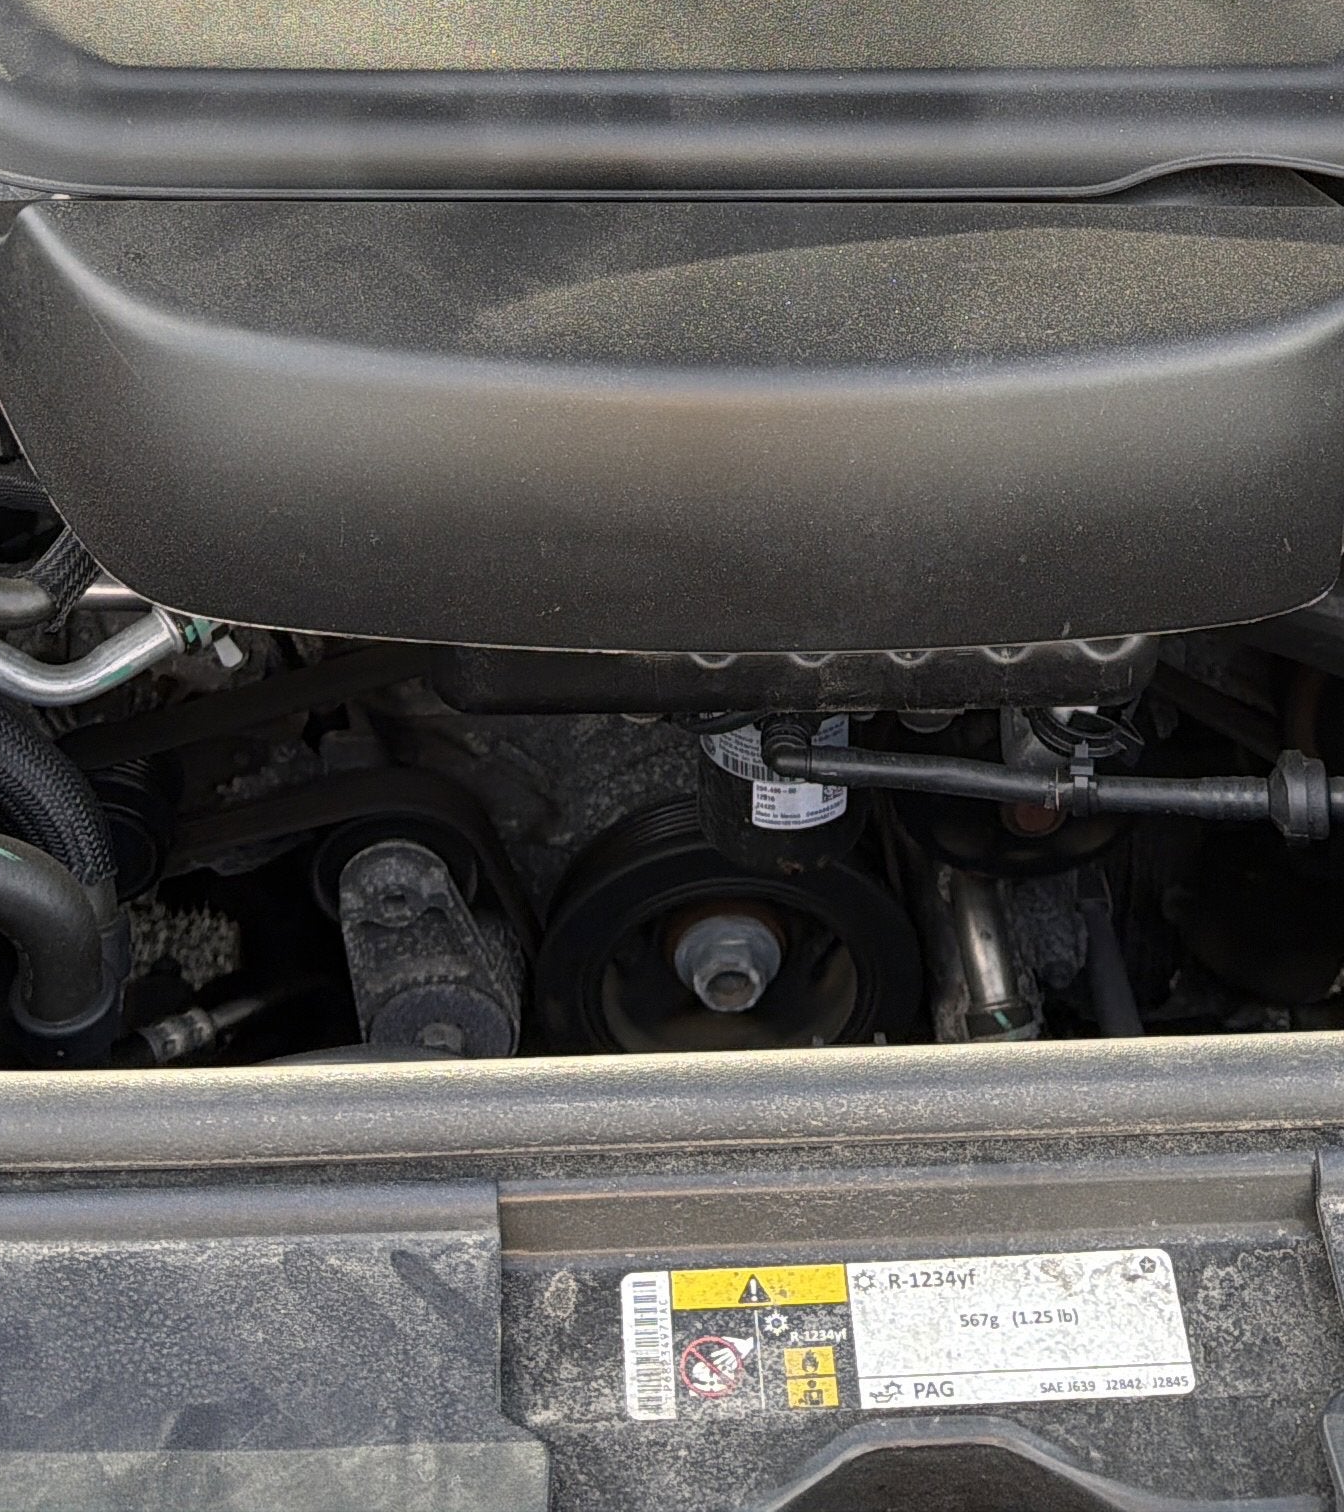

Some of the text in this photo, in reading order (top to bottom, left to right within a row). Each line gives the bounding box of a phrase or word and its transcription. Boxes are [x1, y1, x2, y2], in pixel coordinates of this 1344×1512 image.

[888, 1267, 977, 1290] R-1234yf
[959, 1308, 1079, 1329] 567g (1.25 lb)
[789, 1328, 848, 1343] R-1234yf
[912, 1380, 955, 1399] PAG
[1040, 1381, 1063, 1394] SAE
